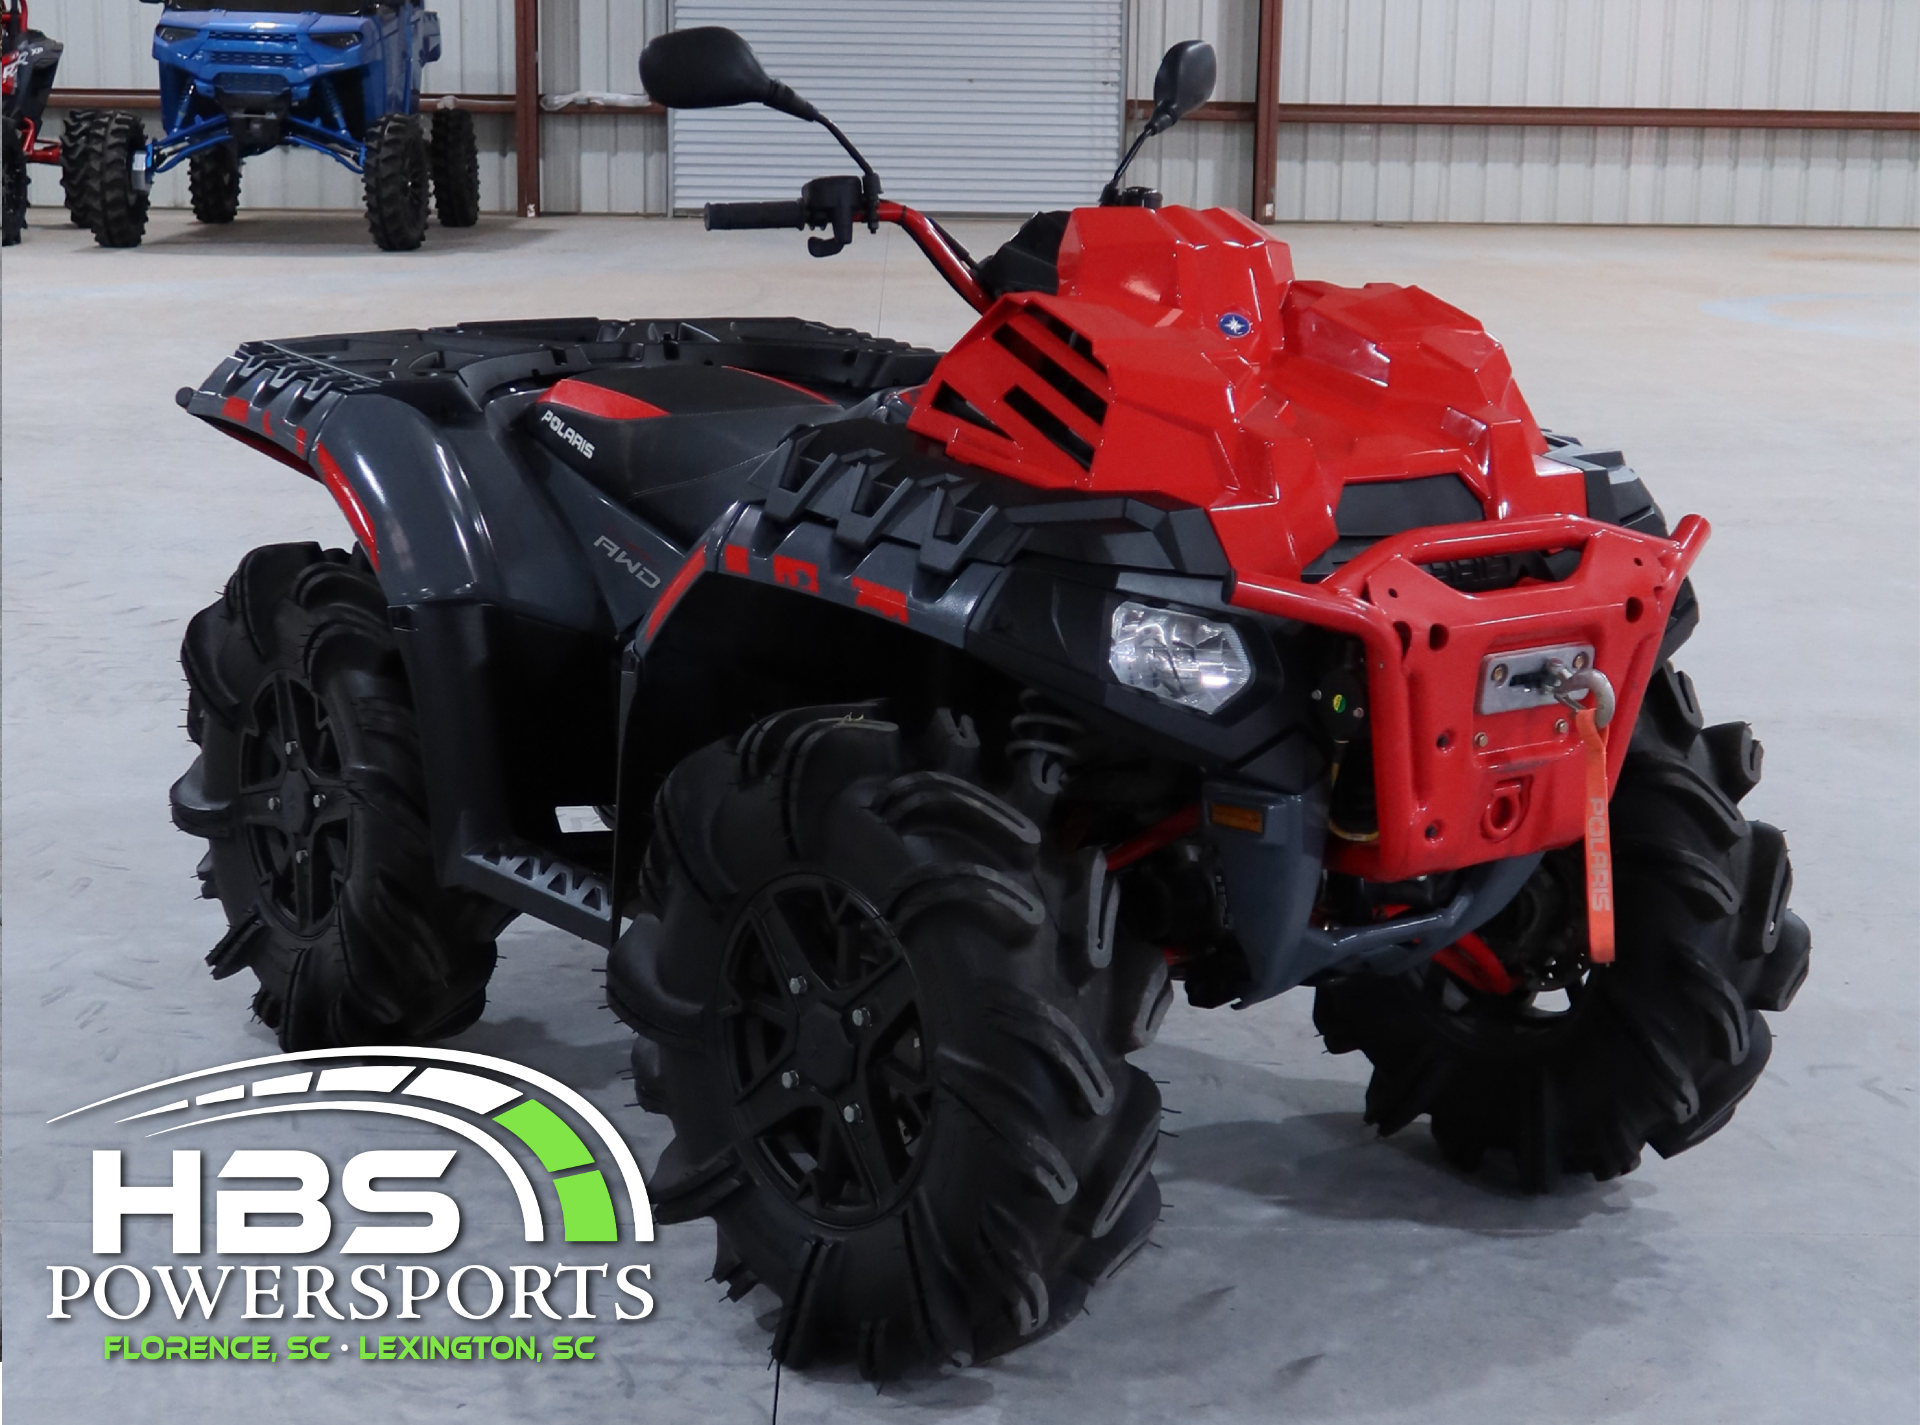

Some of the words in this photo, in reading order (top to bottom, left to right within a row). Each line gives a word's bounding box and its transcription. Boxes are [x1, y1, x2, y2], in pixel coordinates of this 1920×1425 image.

[541, 409, 595, 459] POLARIS
[593, 535, 661, 588] AWD
[1588, 796, 1611, 912] POLARIS
